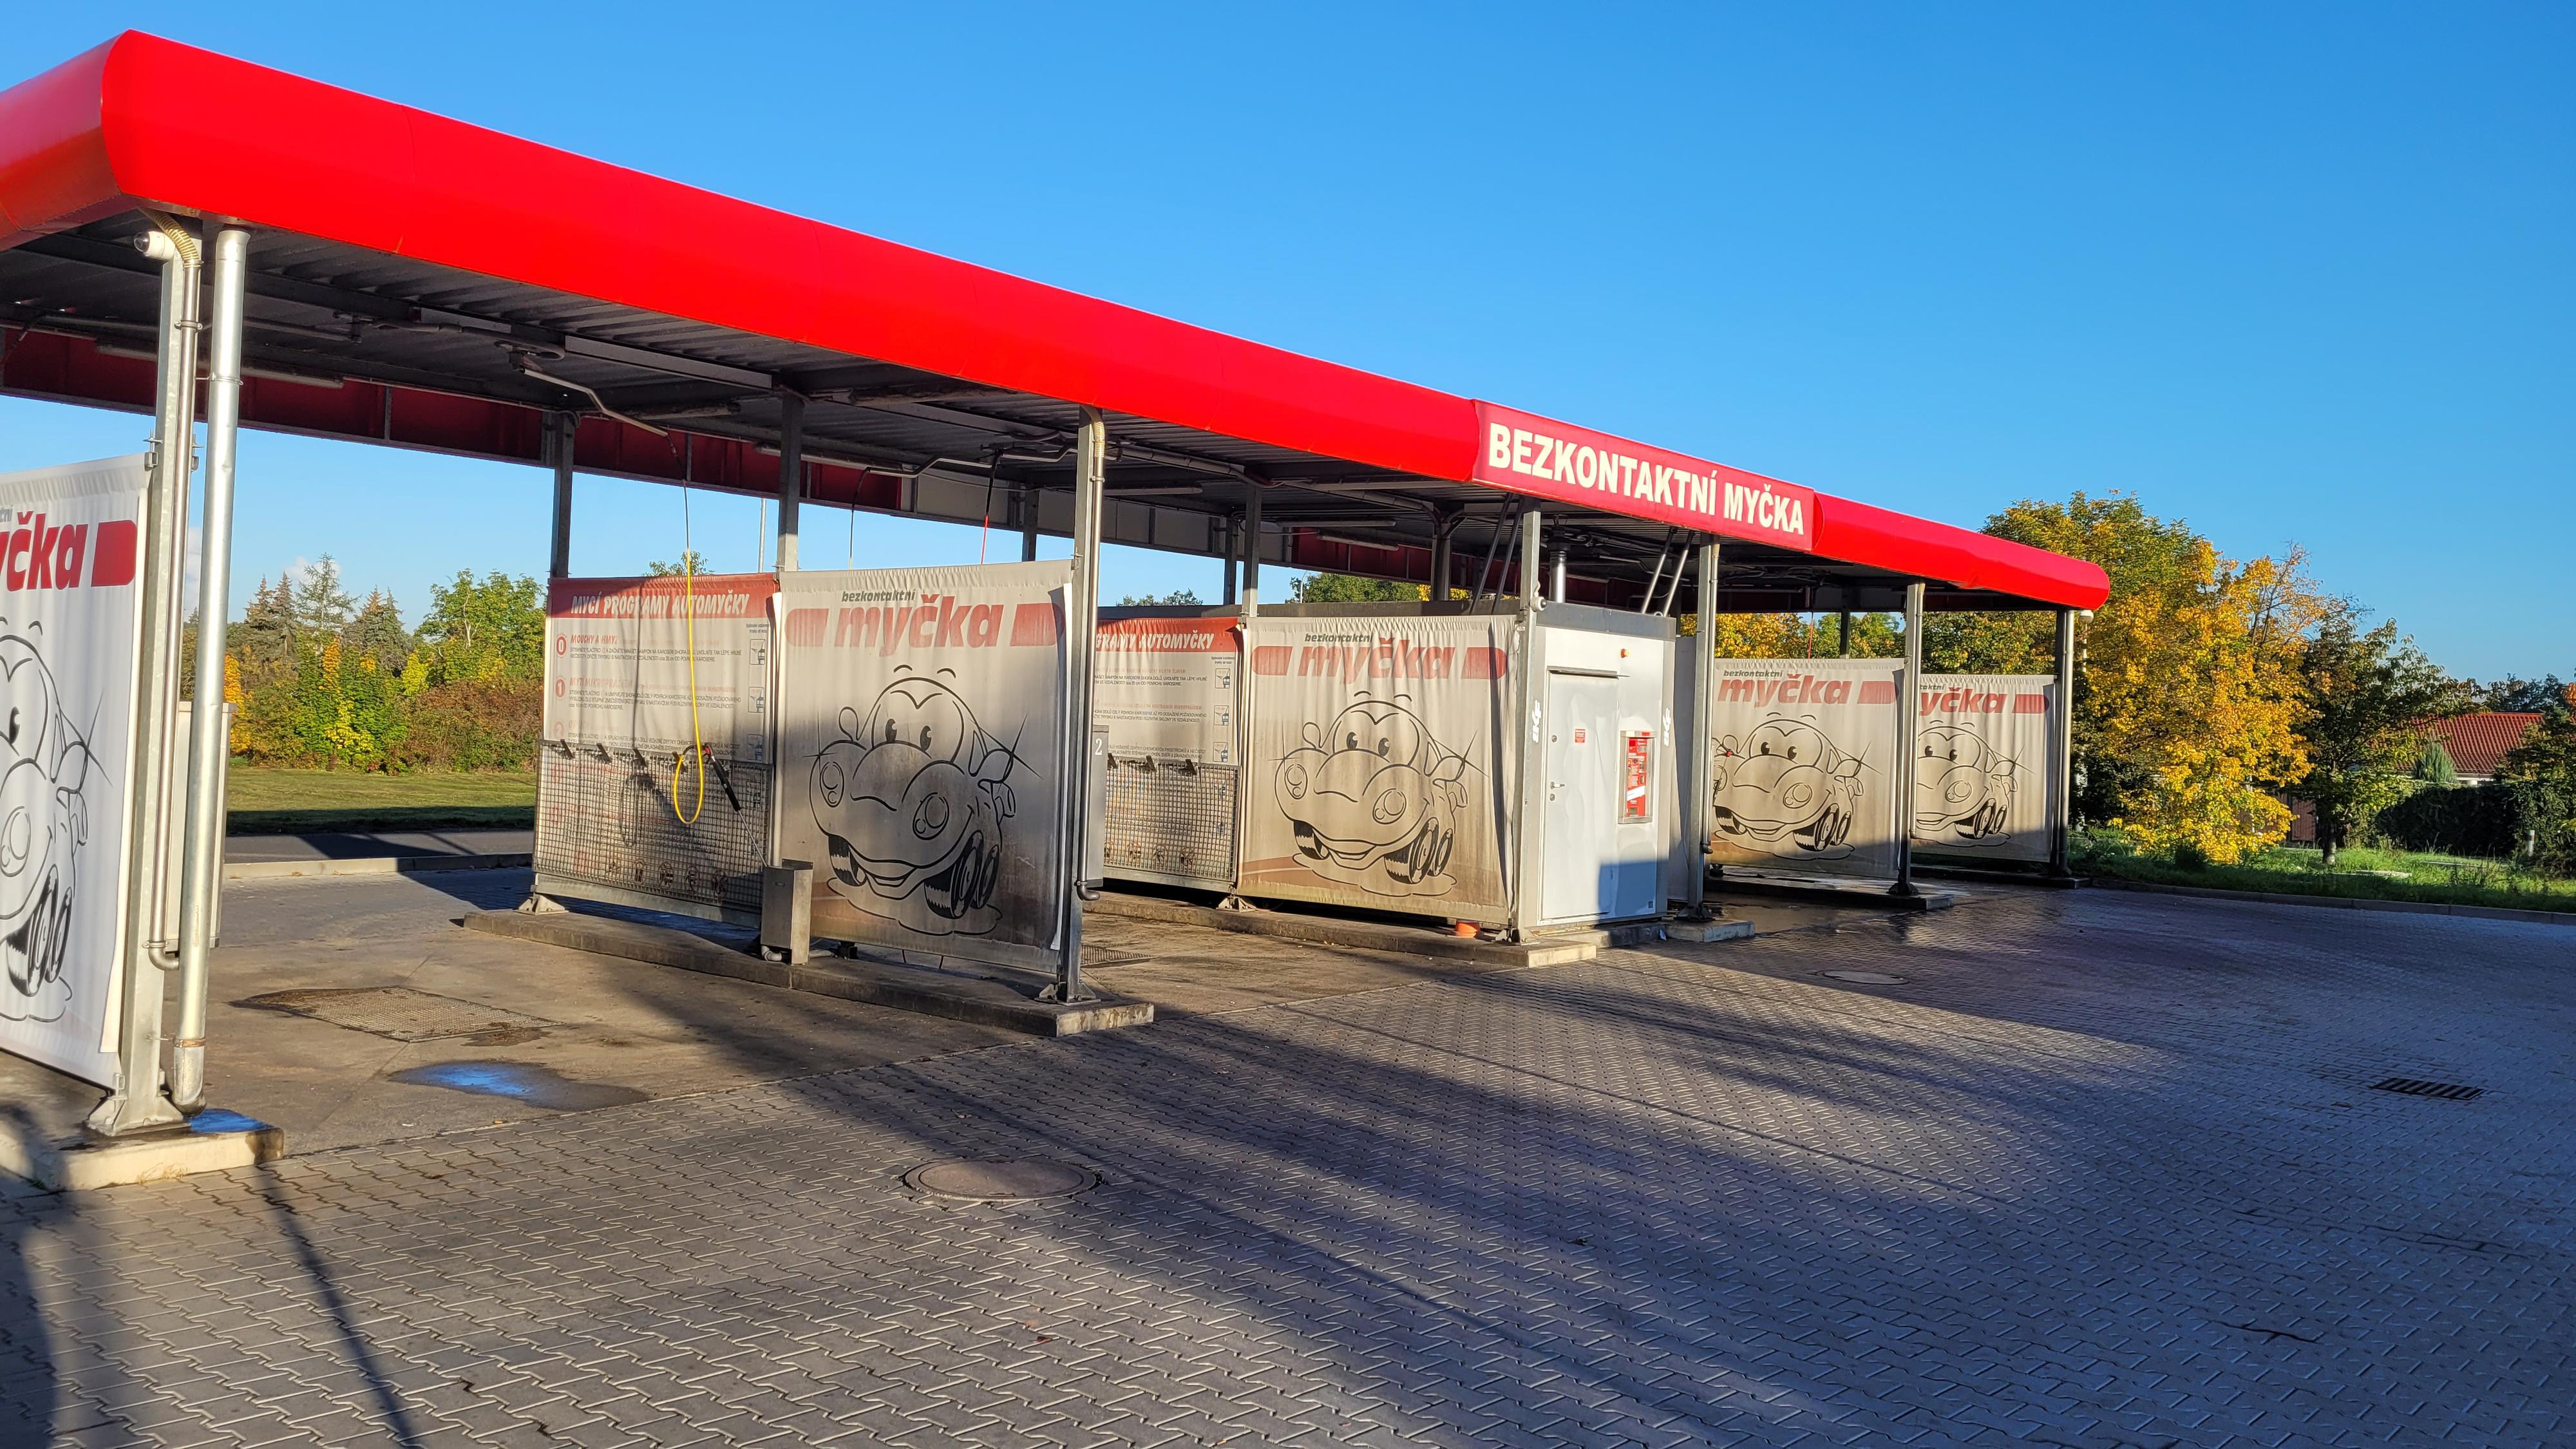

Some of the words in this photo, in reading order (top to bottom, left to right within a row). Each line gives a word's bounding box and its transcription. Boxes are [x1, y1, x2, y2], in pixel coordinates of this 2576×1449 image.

[1488, 422, 1718, 516] BEZKONTAKTNÍ
[1723, 483, 1804, 535] MYČKA
[571, 591, 602, 614] MYCÍ
[603, 595, 670, 615] PROGRAMY
[672, 589, 750, 615] AUTOMYČKY
[841, 589, 916, 603] bezkontaktní
[835, 594, 1004, 658] myčka
[571, 634, 594, 644] MOUCHY
[1139, 629, 1215, 650] AUTOMYČKY
[1305, 633, 1374, 643] bezkontaktní
[1298, 637, 1455, 685] myčka
[1717, 674, 1852, 708] myčka
[1095, 738, 1103, 755] 2
